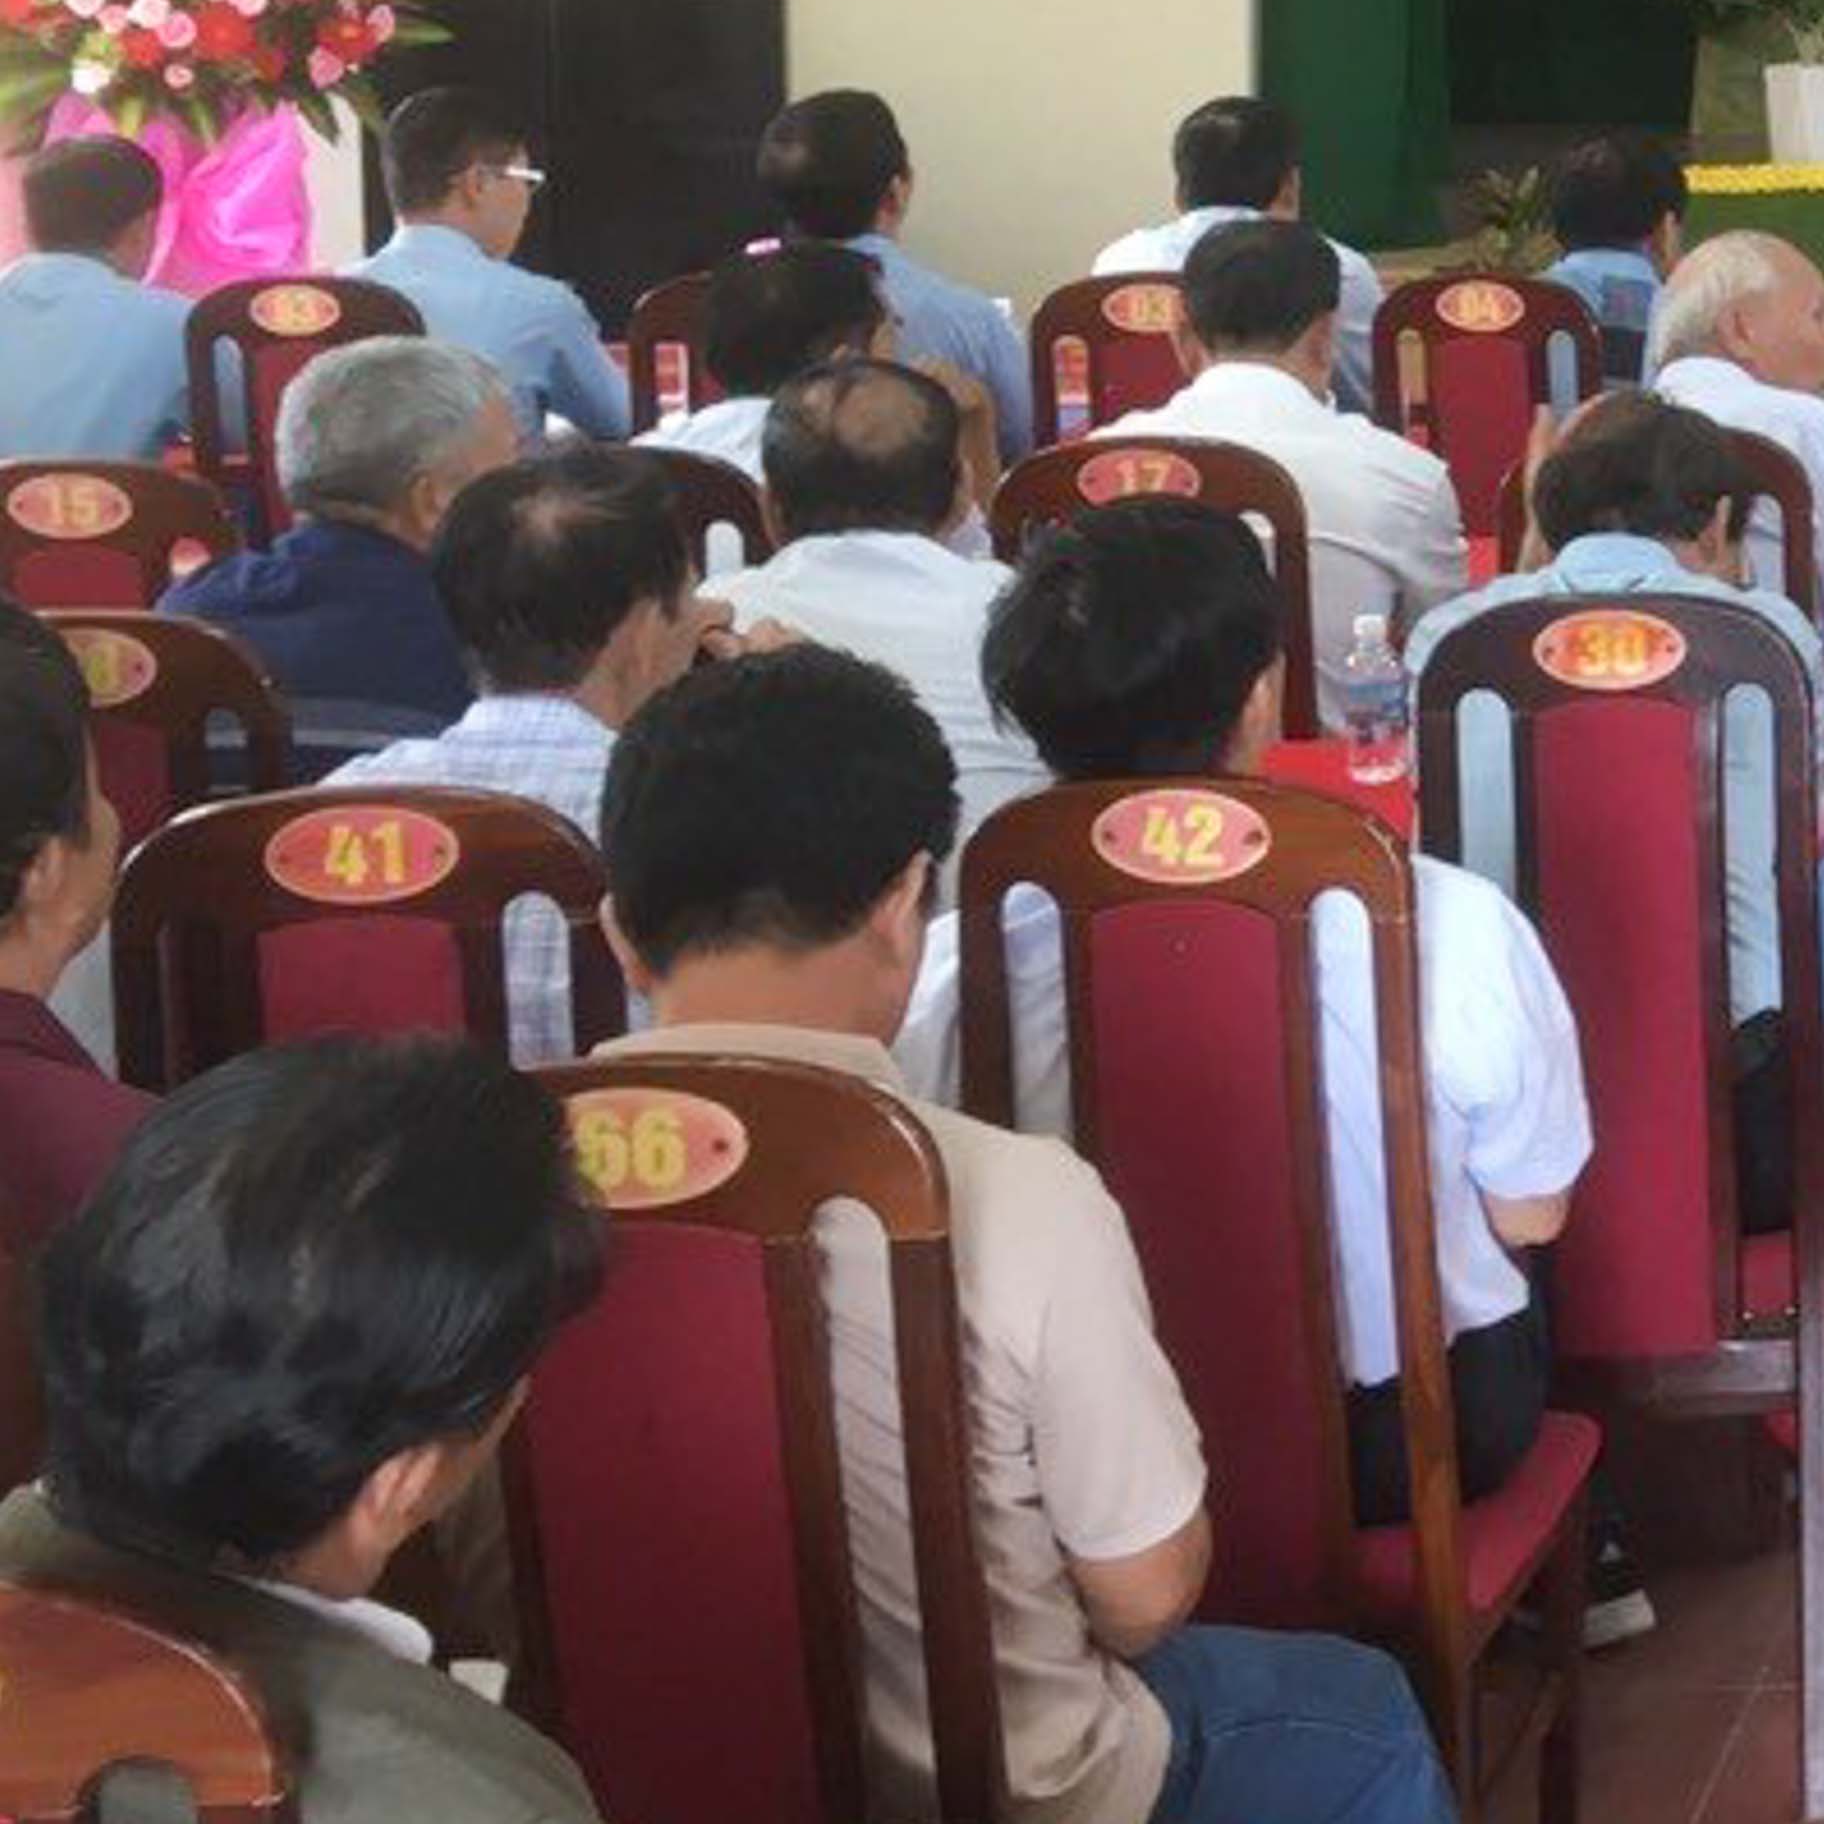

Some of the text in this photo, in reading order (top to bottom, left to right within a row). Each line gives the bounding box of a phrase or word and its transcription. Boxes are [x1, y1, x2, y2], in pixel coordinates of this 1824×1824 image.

[46, 484, 99, 529] 15
[1116, 459, 1171, 498] 17
[1580, 619, 1646, 676] 30
[324, 822, 408, 886] 41
[1141, 806, 1225, 868] 42
